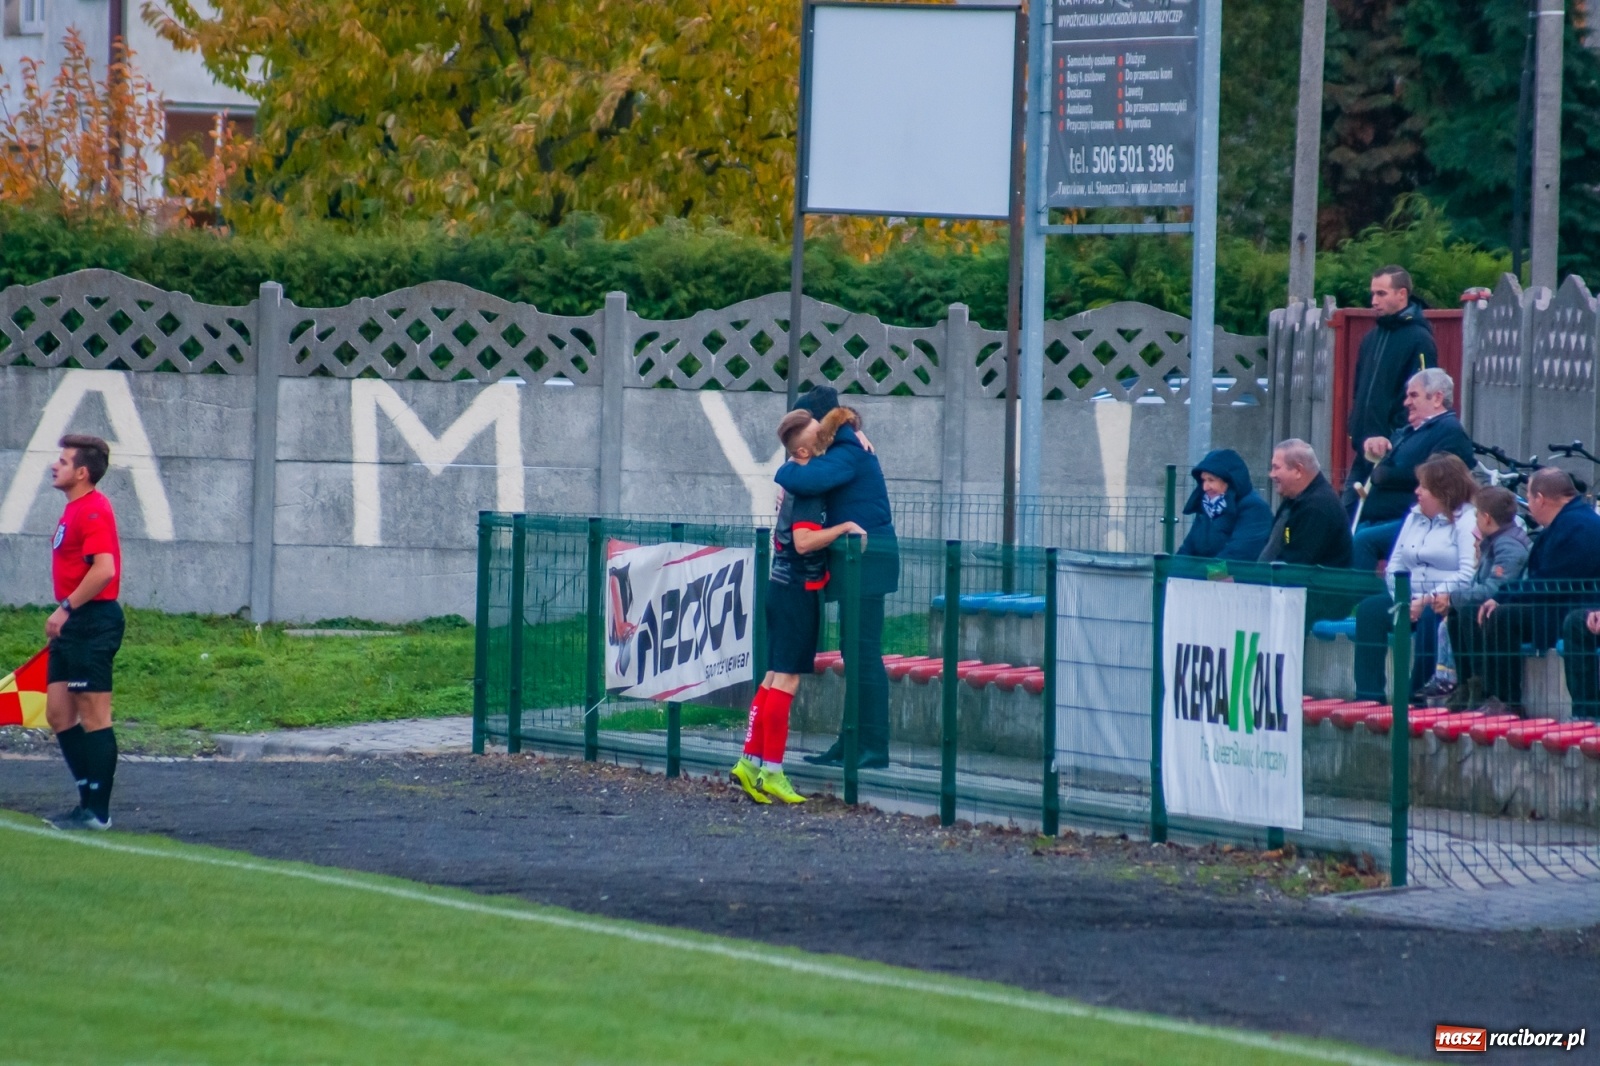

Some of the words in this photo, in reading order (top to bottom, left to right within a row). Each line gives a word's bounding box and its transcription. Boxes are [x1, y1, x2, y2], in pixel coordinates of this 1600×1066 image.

[1095, 54, 1116, 66] osobowe
[1125, 68, 1133, 81] Do
[1133, 70, 1160, 84] przewozu
[1125, 101, 1133, 113] Do
[1133, 103, 1160, 116] przewozu
[1069, 146, 1089, 174] tel.
[1092, 145, 1117, 174] 506
[1119, 145, 1144, 173] 501
[1148, 144, 1174, 172] 396
[1173, 629, 1289, 735] KERAKOLL
